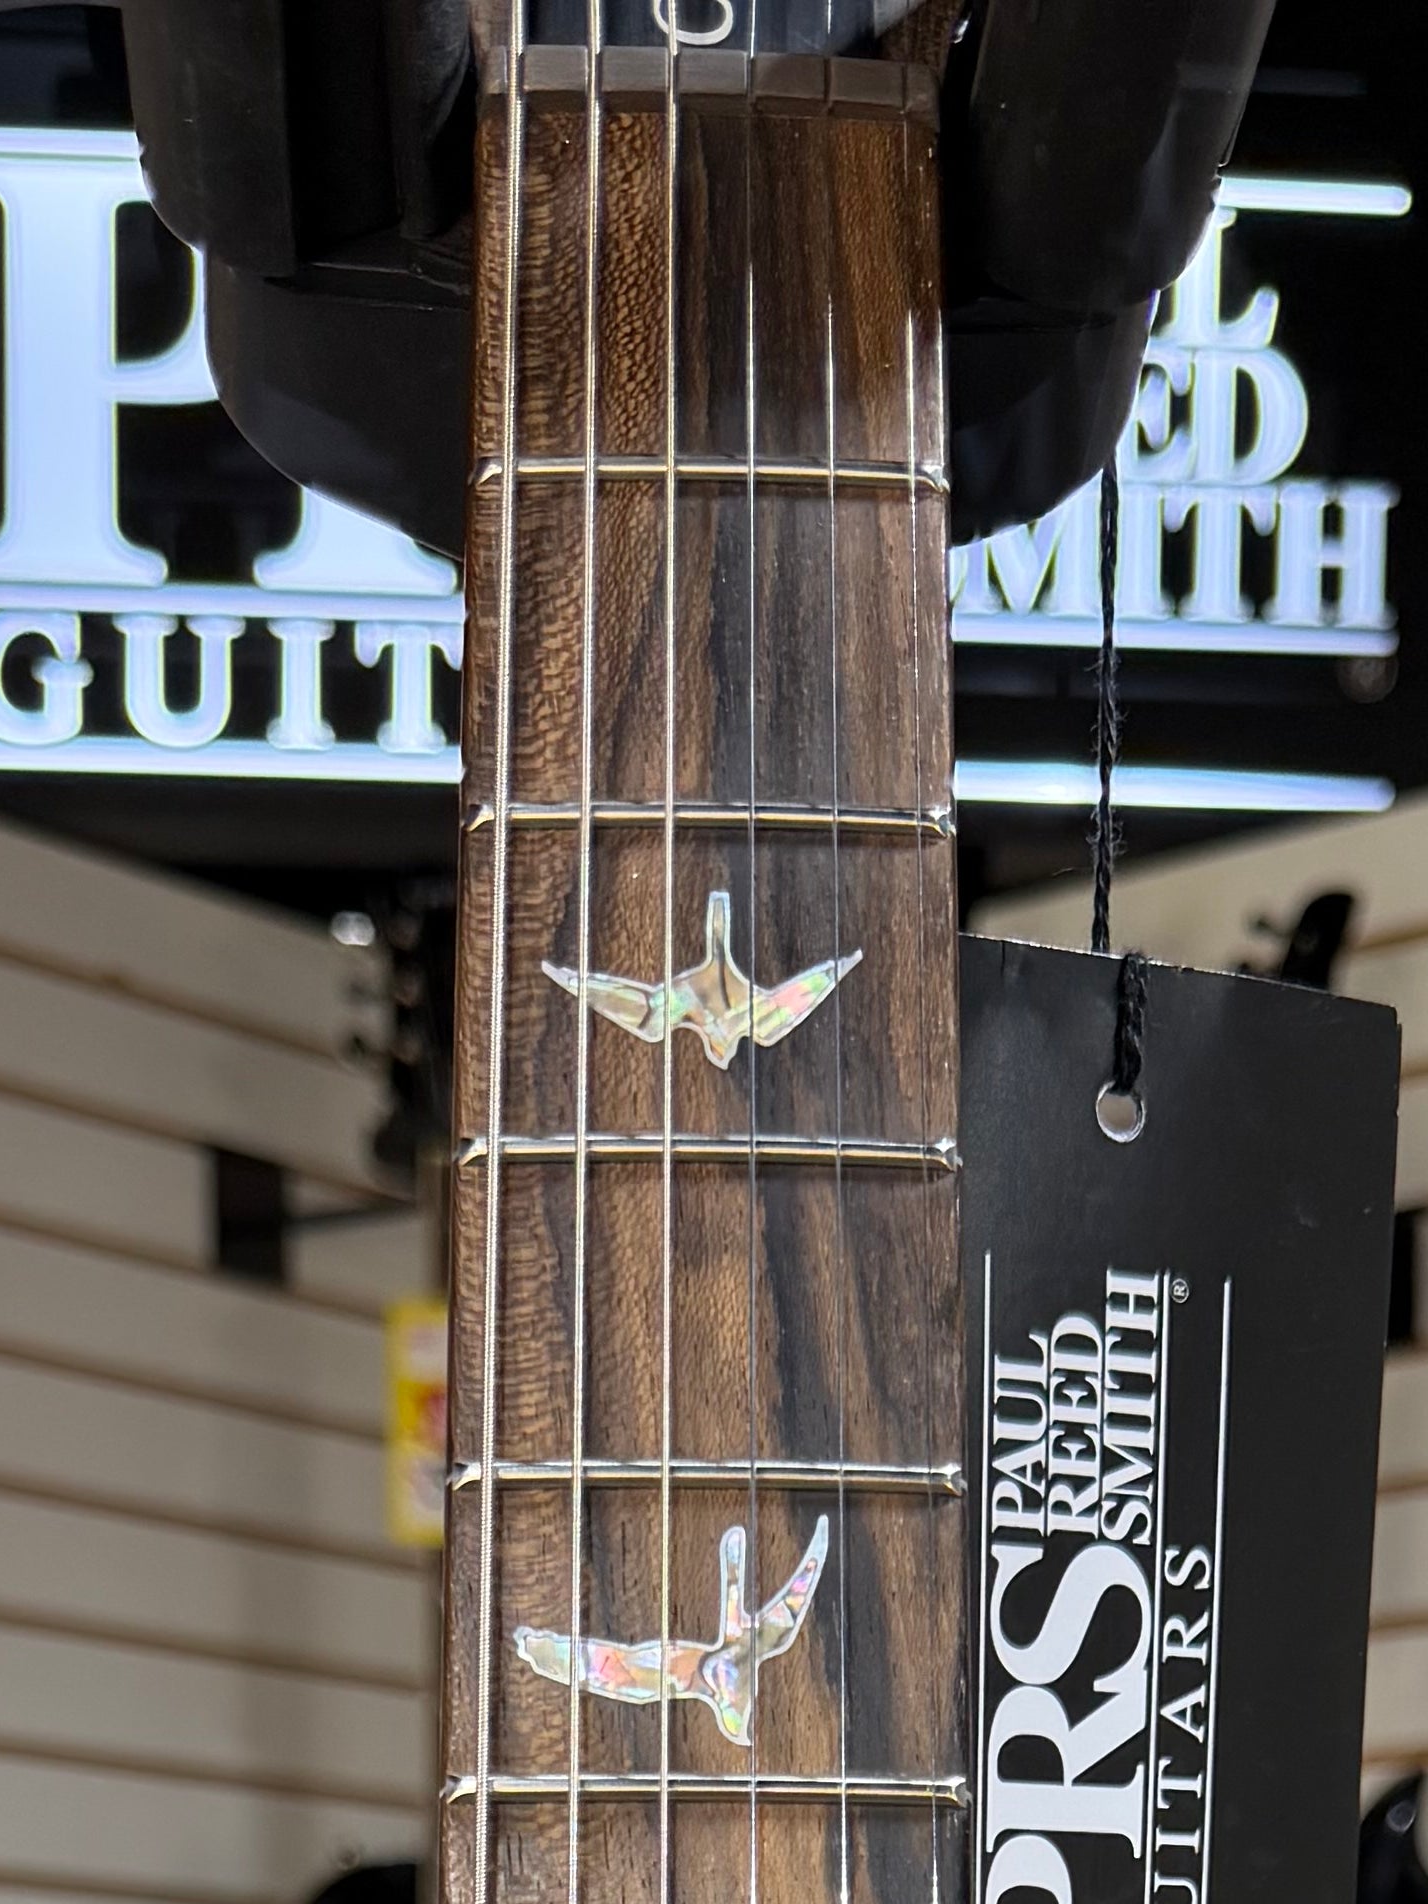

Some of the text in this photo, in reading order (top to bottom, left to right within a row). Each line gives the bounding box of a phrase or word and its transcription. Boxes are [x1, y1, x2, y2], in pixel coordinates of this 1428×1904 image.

[951, 478, 1400, 630] MITH
[990, 1329, 1050, 1534] PAUL
[1046, 1311, 1103, 1539] REED
[1099, 1267, 1163, 1546] SMITH
